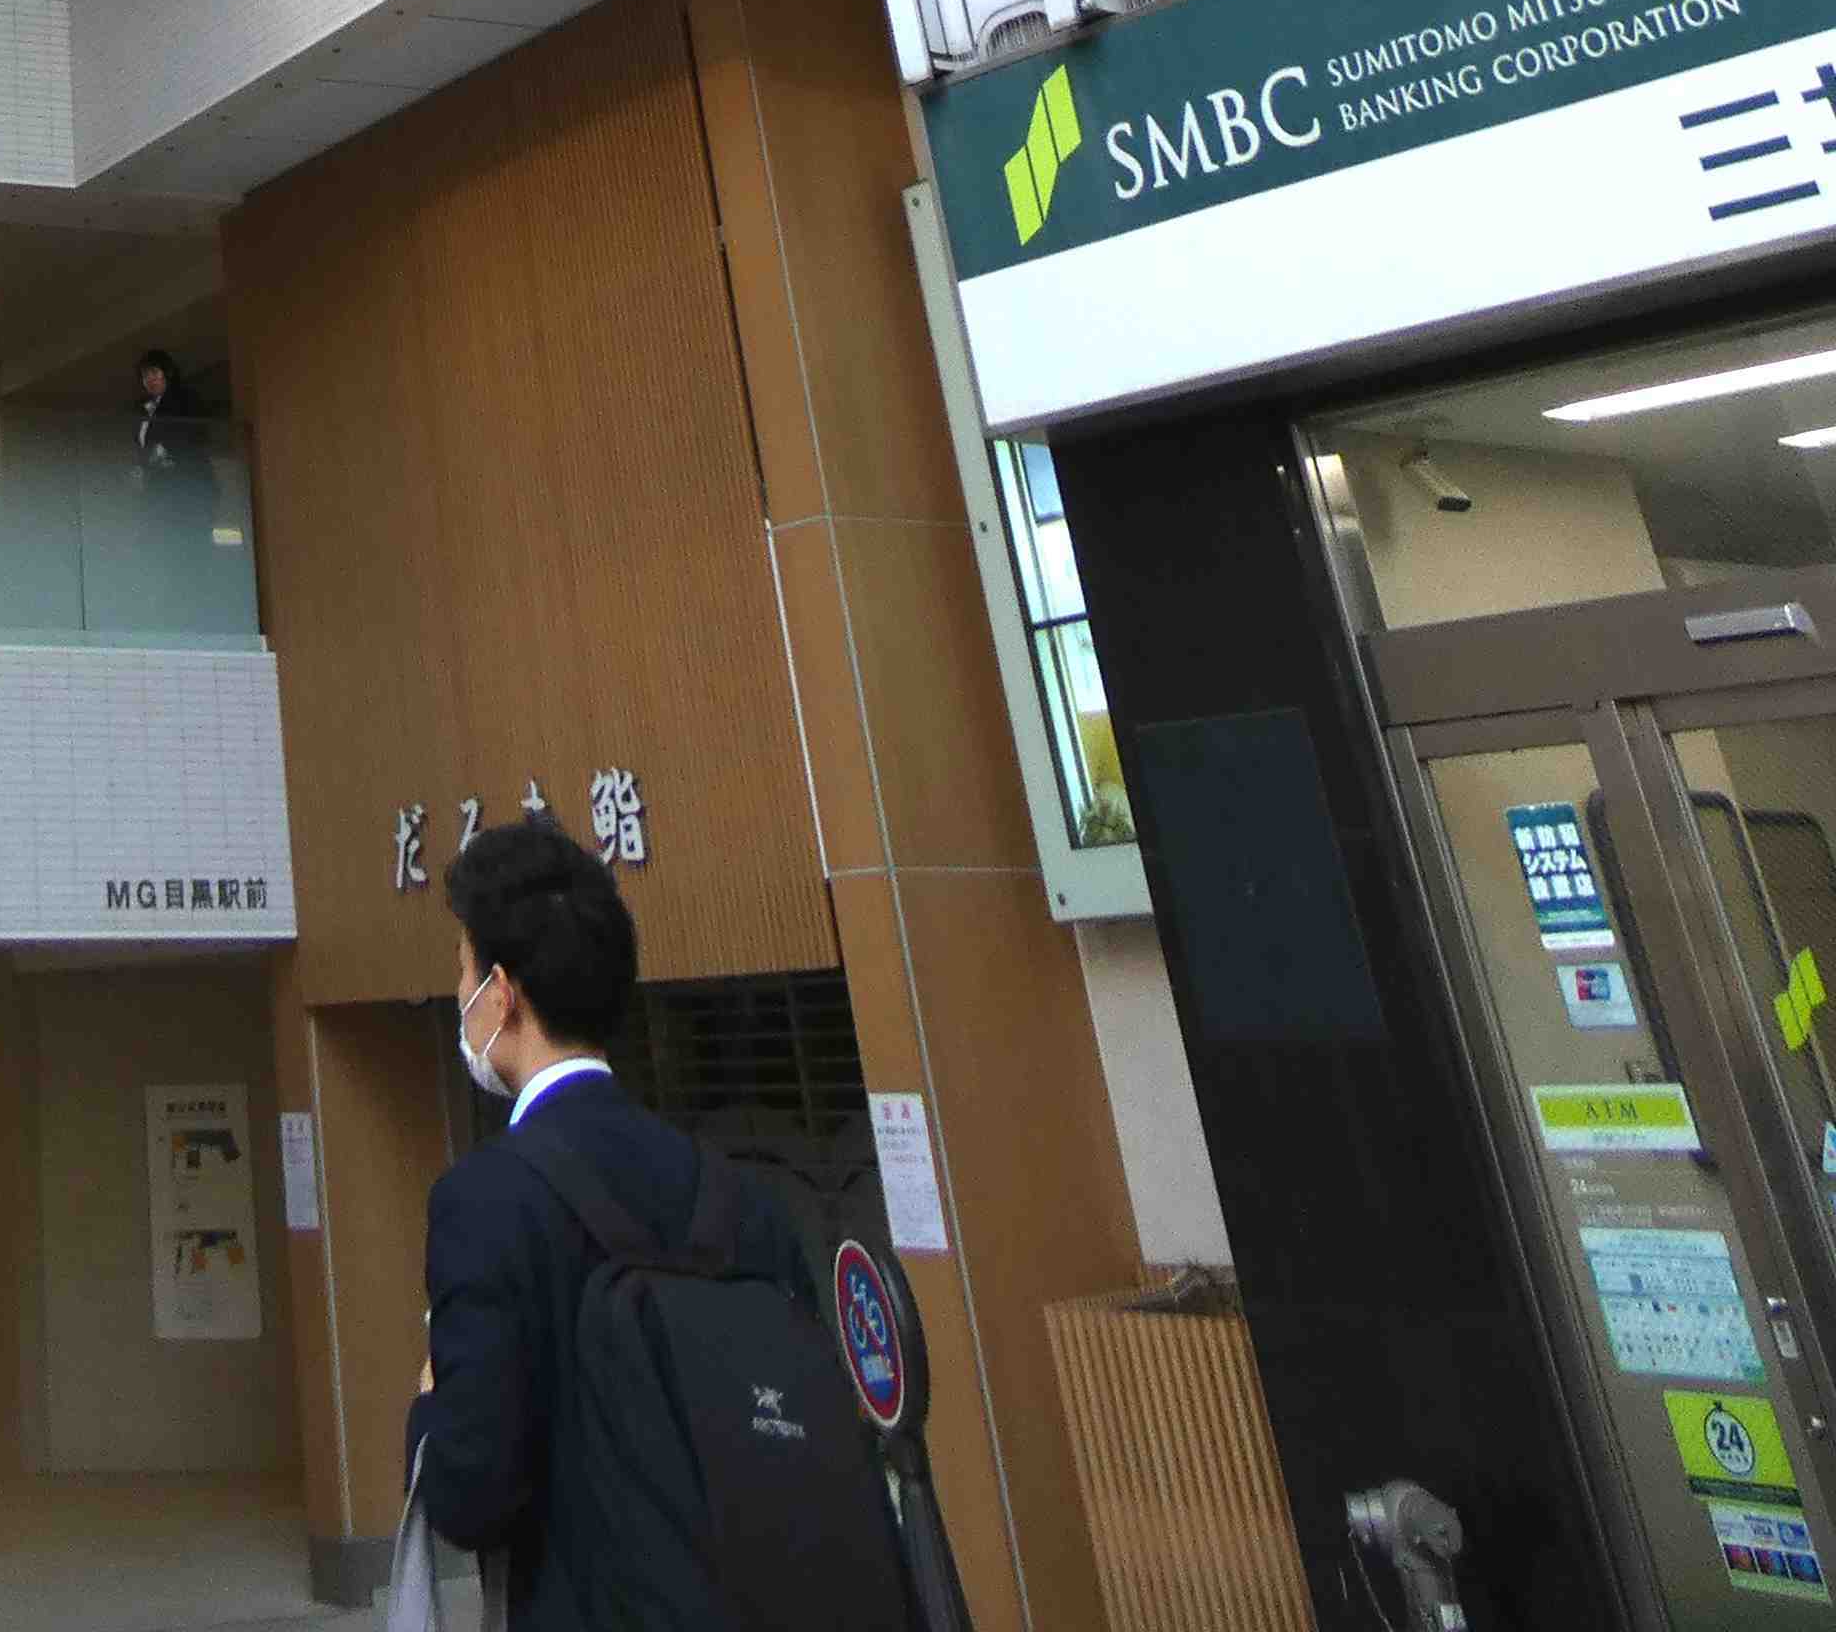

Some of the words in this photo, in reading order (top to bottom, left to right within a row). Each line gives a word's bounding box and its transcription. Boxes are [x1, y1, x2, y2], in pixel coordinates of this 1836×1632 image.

[1326, 10, 1498, 89] SUMITOMO
[1338, 62, 1483, 133] BANKING
[1105, 65, 1323, 201] SMBC
[1522, 848, 1588, 875] システム
[105, 875, 268, 911] MG目黒駅前
[1710, 1419, 1745, 1452] 24
